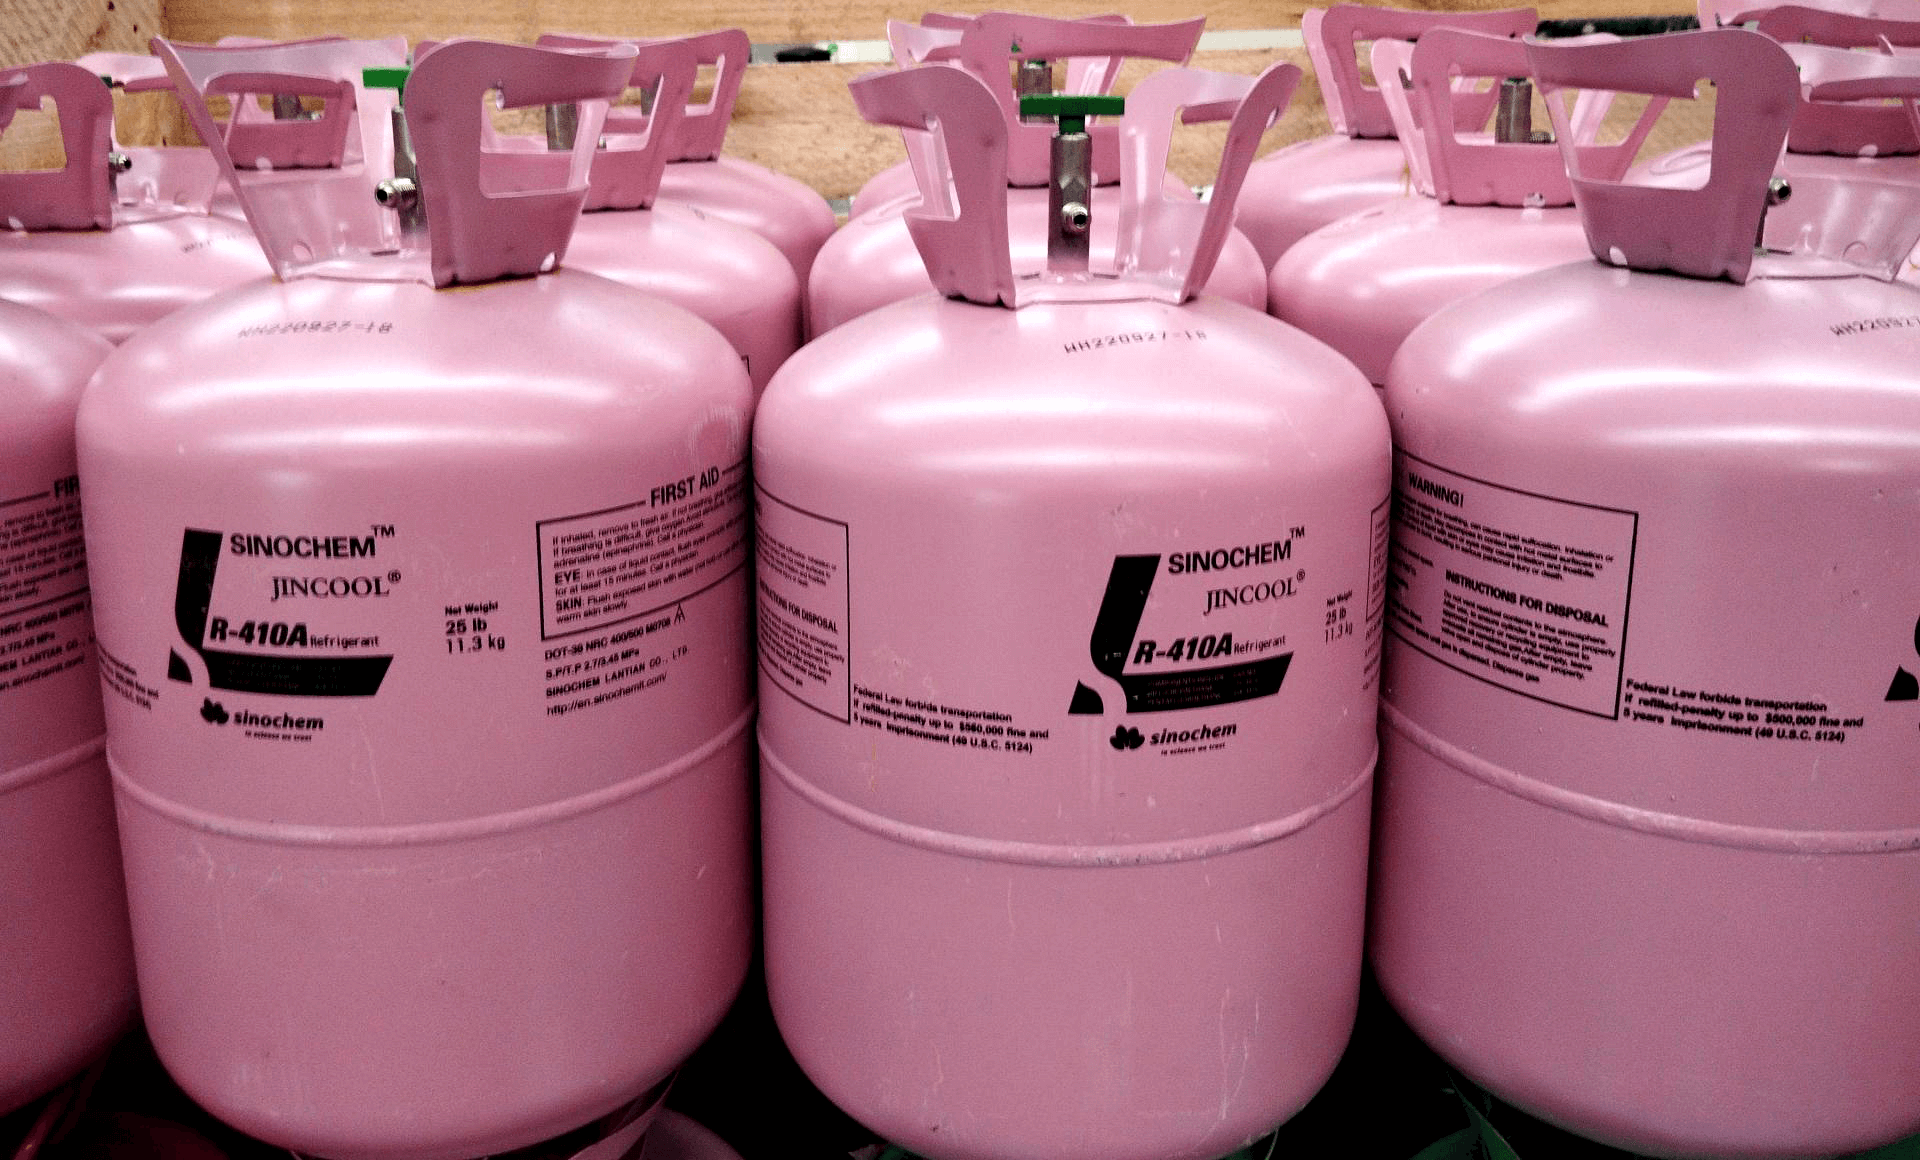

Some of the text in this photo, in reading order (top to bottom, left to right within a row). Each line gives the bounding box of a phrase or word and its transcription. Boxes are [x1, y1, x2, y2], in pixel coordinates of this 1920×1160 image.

[650, 475, 696, 508] FIRST
[699, 466, 720, 491] AID
[1408, 472, 1464, 509] WARNING!
[445, 600, 498, 617] Net Weight
[1445, 569, 1517, 605] INSTRUCTIONS
[1519, 594, 1543, 612] FOR
[1545, 601, 1609, 628] DISPOSAL
[209, 616, 380, 650] R-410A Refrigerant
[472, 618, 488, 633] lb
[446, 633, 505, 654] 11.3 kg
[1133, 632, 1286, 665] R-410A Refrigerant
[545, 676, 601, 698] SINOCHEM
[604, 662, 646, 683] LANTIAN
[1626, 678, 1670, 696] Federal
[1671, 686, 1697, 700] Law
[1744, 696, 1828, 712] transportation
[234, 709, 324, 730] sinochem
[940, 704, 1012, 723] transportation
[1632, 710, 1665, 725] years
[1670, 715, 1753, 736] imprisonment
[1814, 729, 1845, 744] 5124)
[1638, 697, 1726, 721] refilled-penalty
[1728, 711, 1745, 724] up
[1746, 711, 1760, 723] to
[1819, 714, 1841, 728] fine
[1842, 715, 1864, 728] and
[929, 718, 941, 731] up
[943, 718, 954, 730] to
[1006, 724, 1027, 738] fine
[1029, 728, 1050, 740] and
[1150, 723, 1237, 746] sinochem
